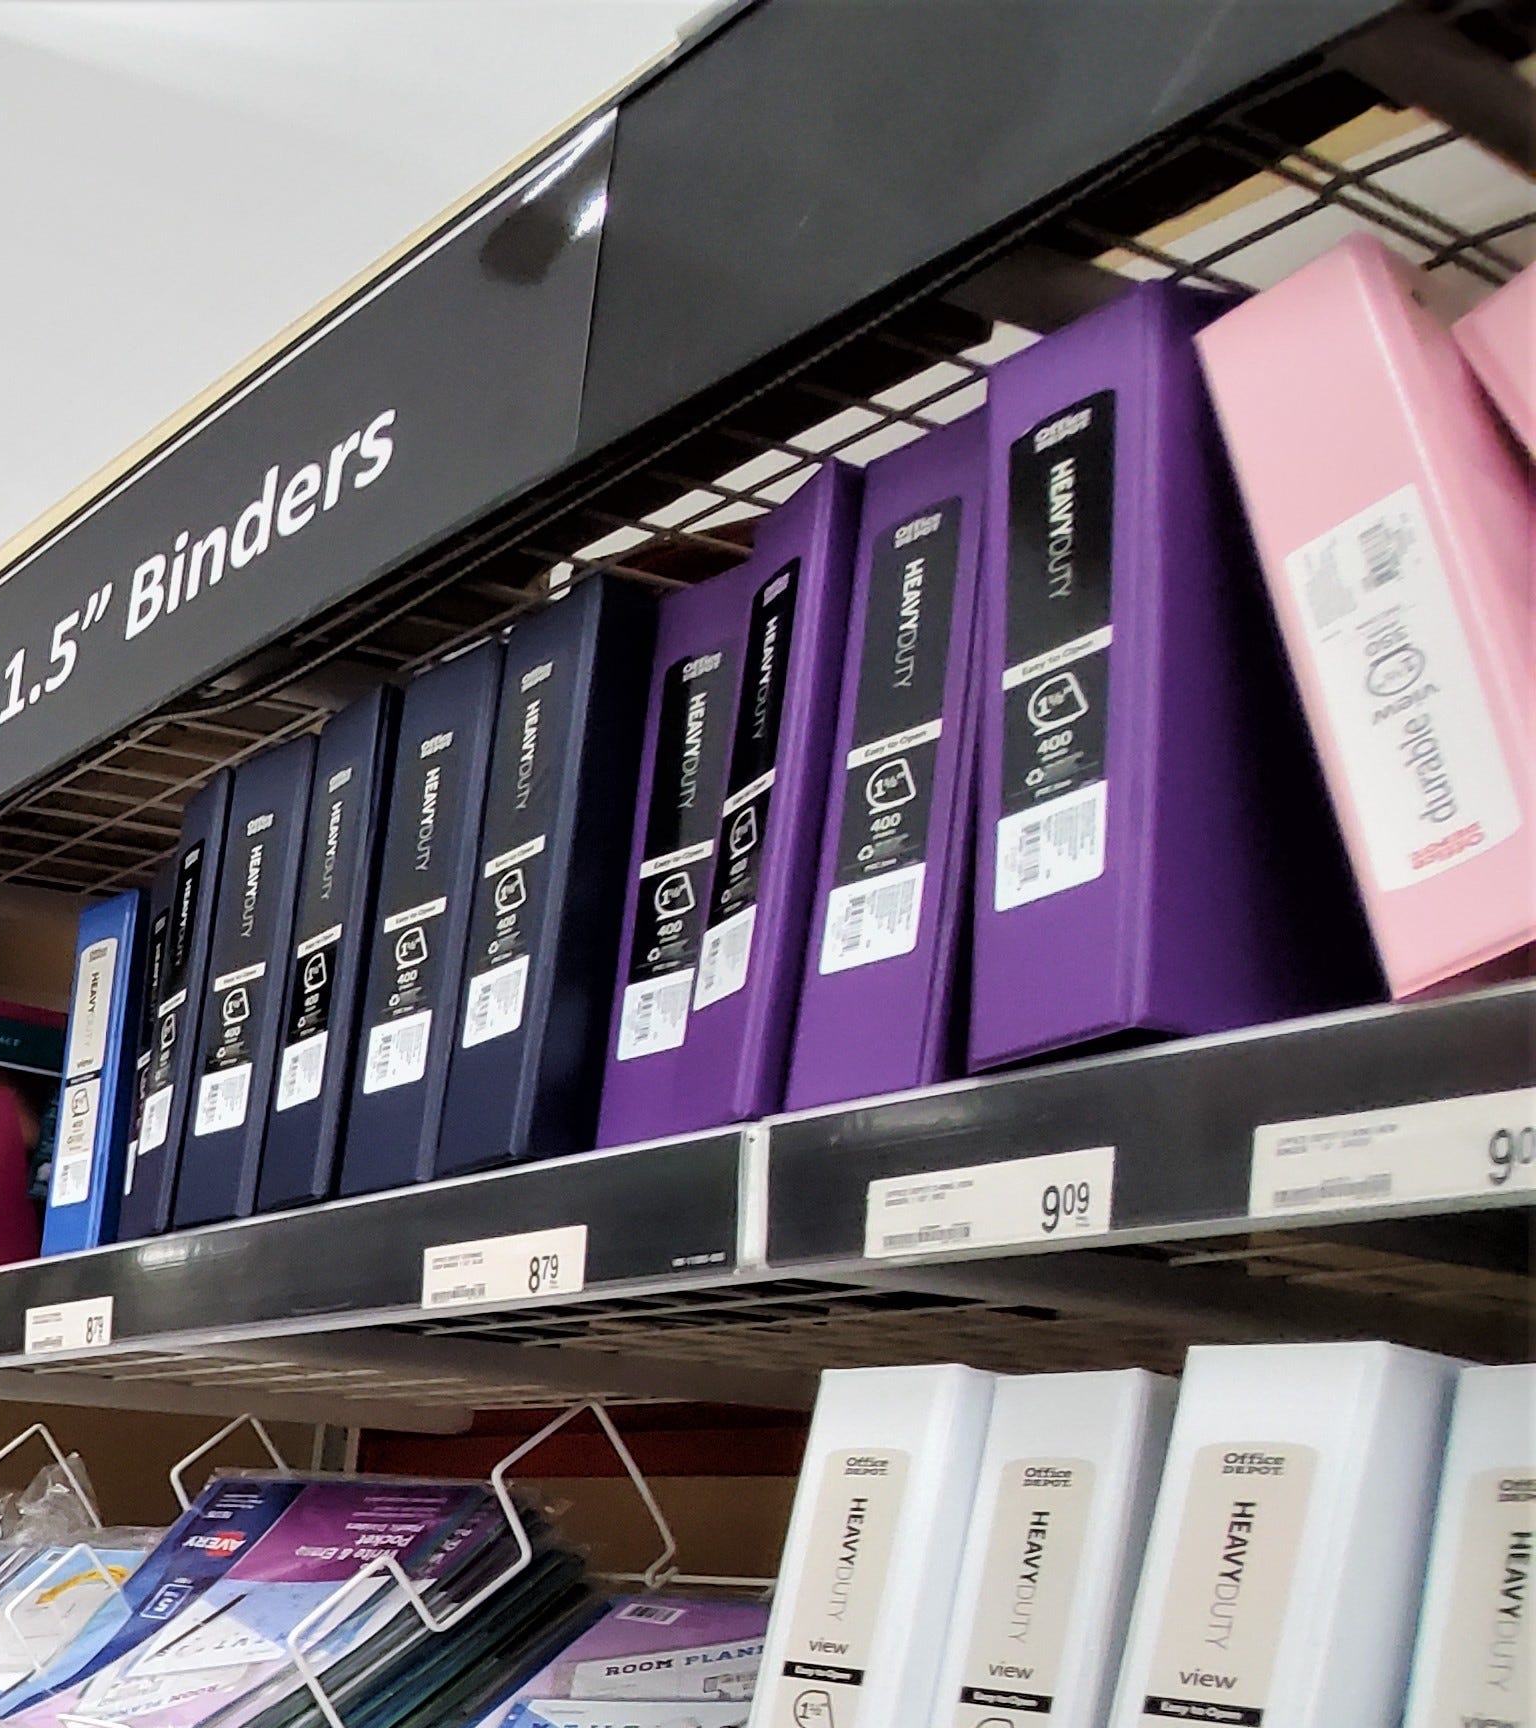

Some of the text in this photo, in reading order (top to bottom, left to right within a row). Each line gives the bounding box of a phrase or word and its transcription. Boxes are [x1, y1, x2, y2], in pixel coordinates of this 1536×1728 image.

[124, 408, 396, 640] Binders
[1048, 457, 1076, 599] HEAVYDUTY
[893, 557, 925, 690] HEAVYDUTY
[752, 615, 779, 741] HEAVYDUTY
[516, 699, 540, 810] HEAVYDUTY
[677, 691, 706, 810] HEAVYDUTY
[1037, 729, 1073, 755] 400
[1400, 713, 1459, 824] durable
[321, 800, 344, 902] HEAVYDUTY
[416, 764, 441, 871] HEAVYDUTY
[870, 813, 902, 831] 400
[240, 843, 264, 939] HEAVYDUTY
[1041, 1181, 1091, 1233] 909
[528, 1254, 559, 1293] 879
[846, 1455, 889, 1469] Office
[1024, 1466, 1072, 1480] Office
[1223, 1451, 1285, 1466] Office
[181, 1532, 248, 1556] AVERY
[355, 1534, 416, 1547] Pocket
[827, 1497, 868, 1622] HEAVYDUTY
[1008, 1511, 1050, 1645] HEAVYDUTY
[1203, 1500, 1258, 1653] HEAVYDUTY
[808, 1636, 849, 1655] view
[1486, 1531, 1533, 1692] HEAVYDUTY
[605, 1644, 765, 1677] ROOM PLAN
[987, 1660, 1034, 1680] view
[1179, 1668, 1237, 1690] view
